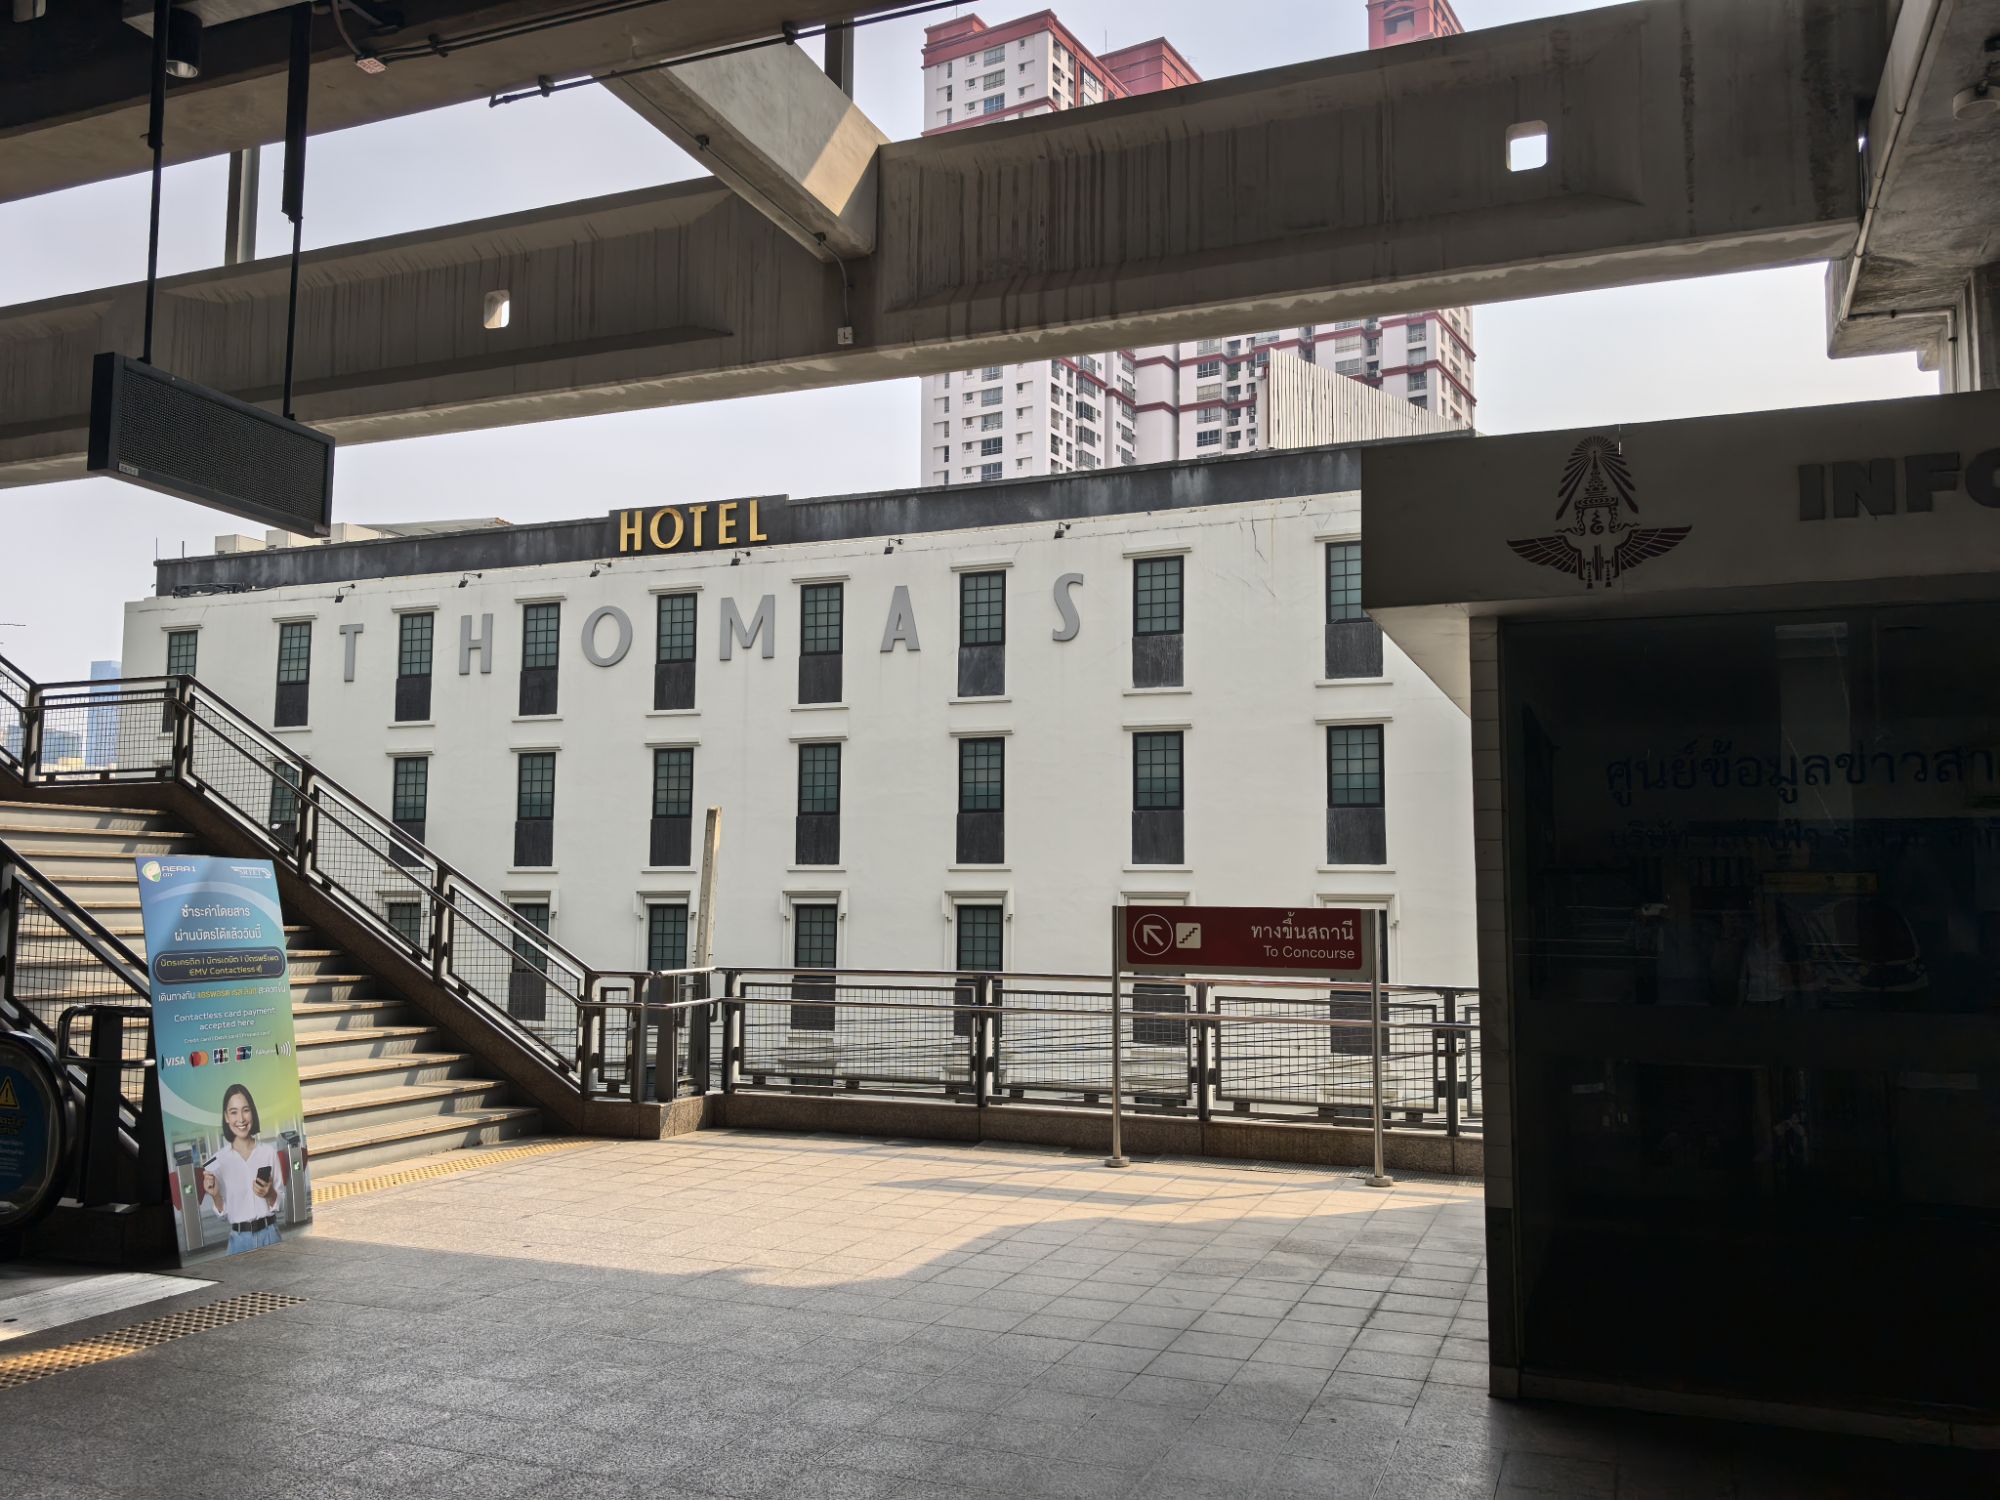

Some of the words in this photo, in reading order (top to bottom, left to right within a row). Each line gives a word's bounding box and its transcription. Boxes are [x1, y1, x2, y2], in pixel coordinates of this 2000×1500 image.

[619, 500, 768, 552] HOTEL
[339, 572, 1084, 683] THOMAS
[181, 904, 250, 918] ชำระค่าโดยสาร
[174, 923, 262, 942] ผ่านบัตรได้แล้ววันนี้
[1251, 911, 1355, 940] ทางขึ้นสถานี
[1263, 945, 1279, 957] To
[1282, 945, 1355, 959] Concourse
[209, 967, 256, 976] Contactless
[174, 1010, 222, 1022] Contactless
[224, 1009, 241, 1018] card
[243, 1007, 275, 1018] payment
[200, 1020, 236, 1031] accepted
[237, 1018, 255, 1027] here
[165, 1057, 186, 1067] VISA
